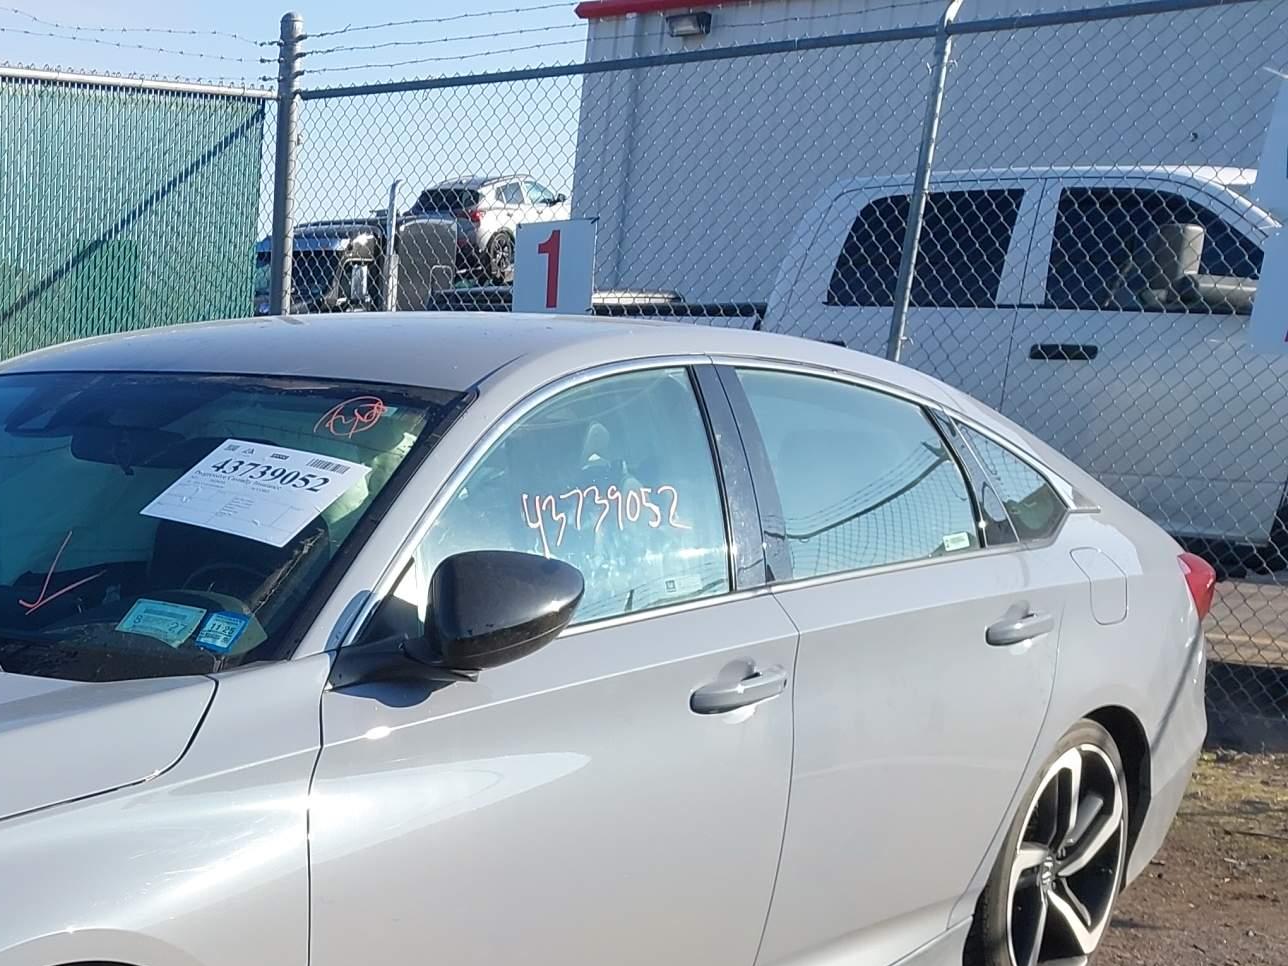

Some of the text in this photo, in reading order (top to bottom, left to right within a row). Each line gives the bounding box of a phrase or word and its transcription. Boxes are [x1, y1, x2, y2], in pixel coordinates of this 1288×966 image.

[537, 229, 561, 308] 1
[211, 458, 330, 492] 43739052
[520, 485, 693, 559] 43739052
